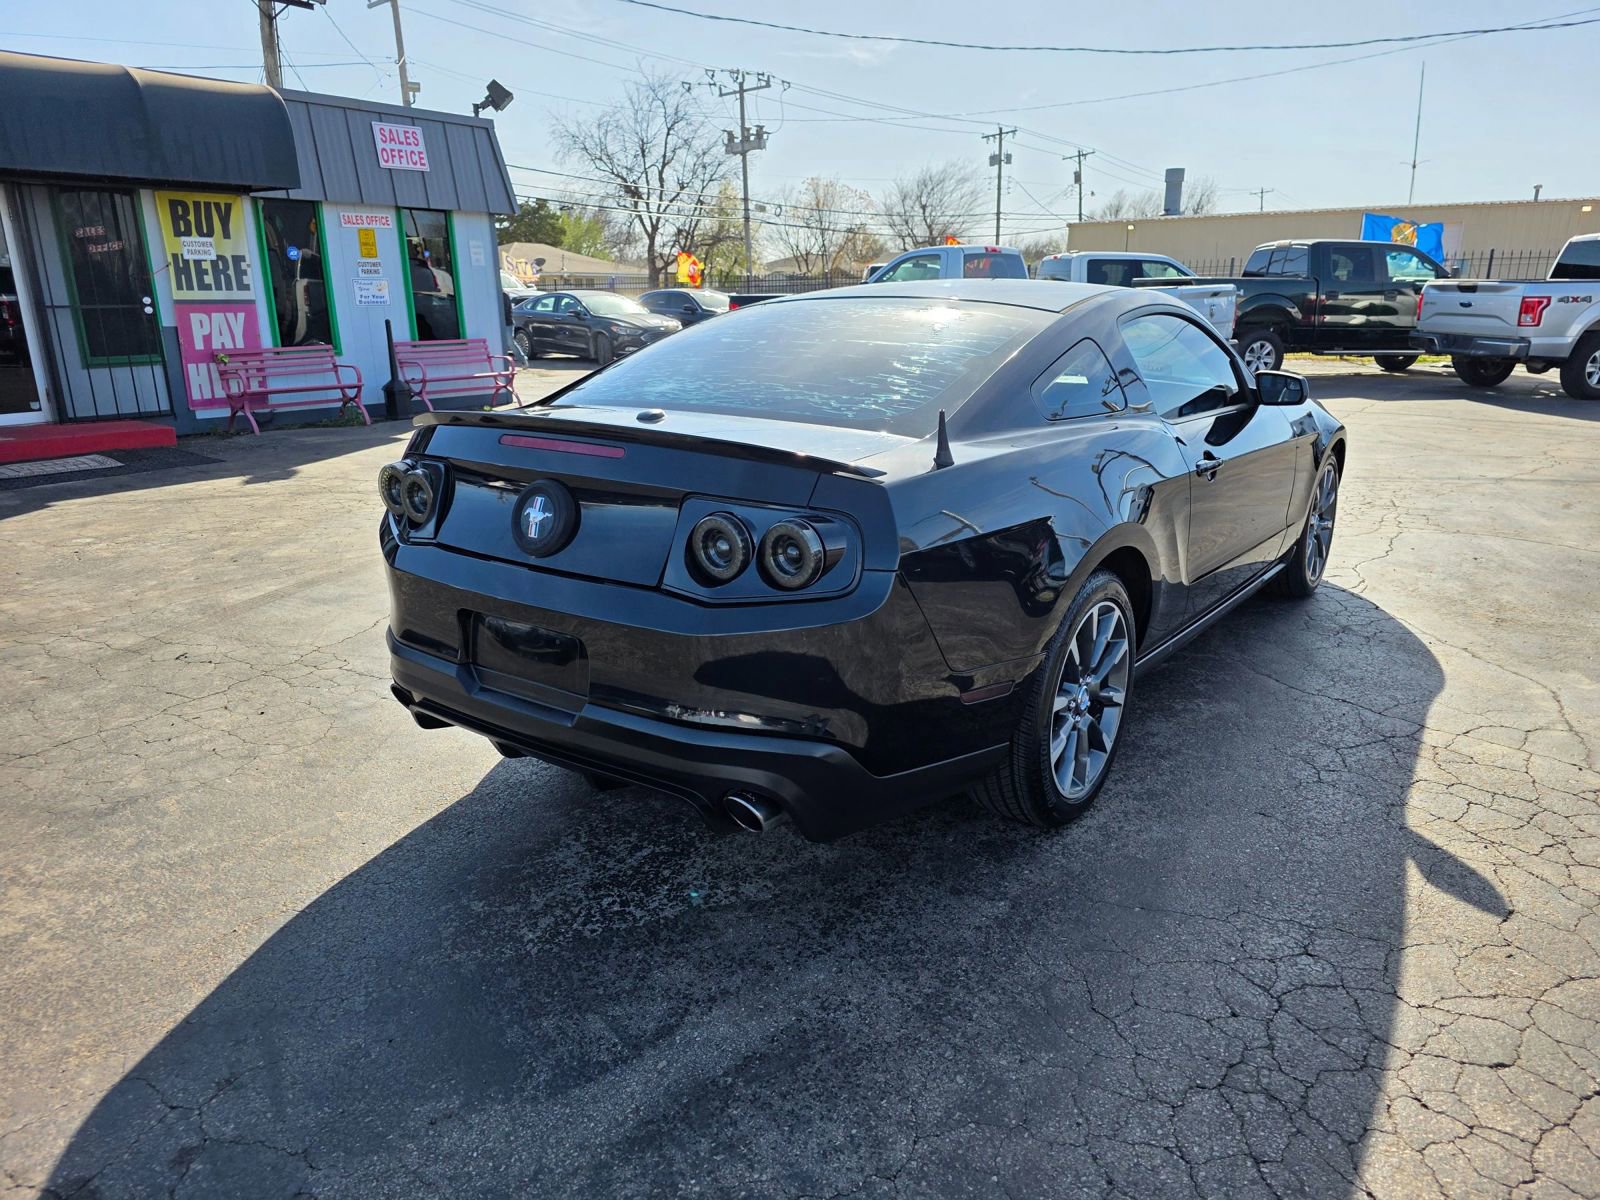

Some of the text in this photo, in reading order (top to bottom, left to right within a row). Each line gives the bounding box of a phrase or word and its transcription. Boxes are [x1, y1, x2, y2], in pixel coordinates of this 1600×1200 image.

[379, 127, 420, 147] SALES
[380, 147, 427, 167] OFFICE
[168, 198, 232, 240] BUY
[342, 214, 391, 226] SALES OFFICE
[186, 248, 212, 256] PARKING
[171, 253, 251, 291] HERE
[189, 312, 245, 351] PAY
